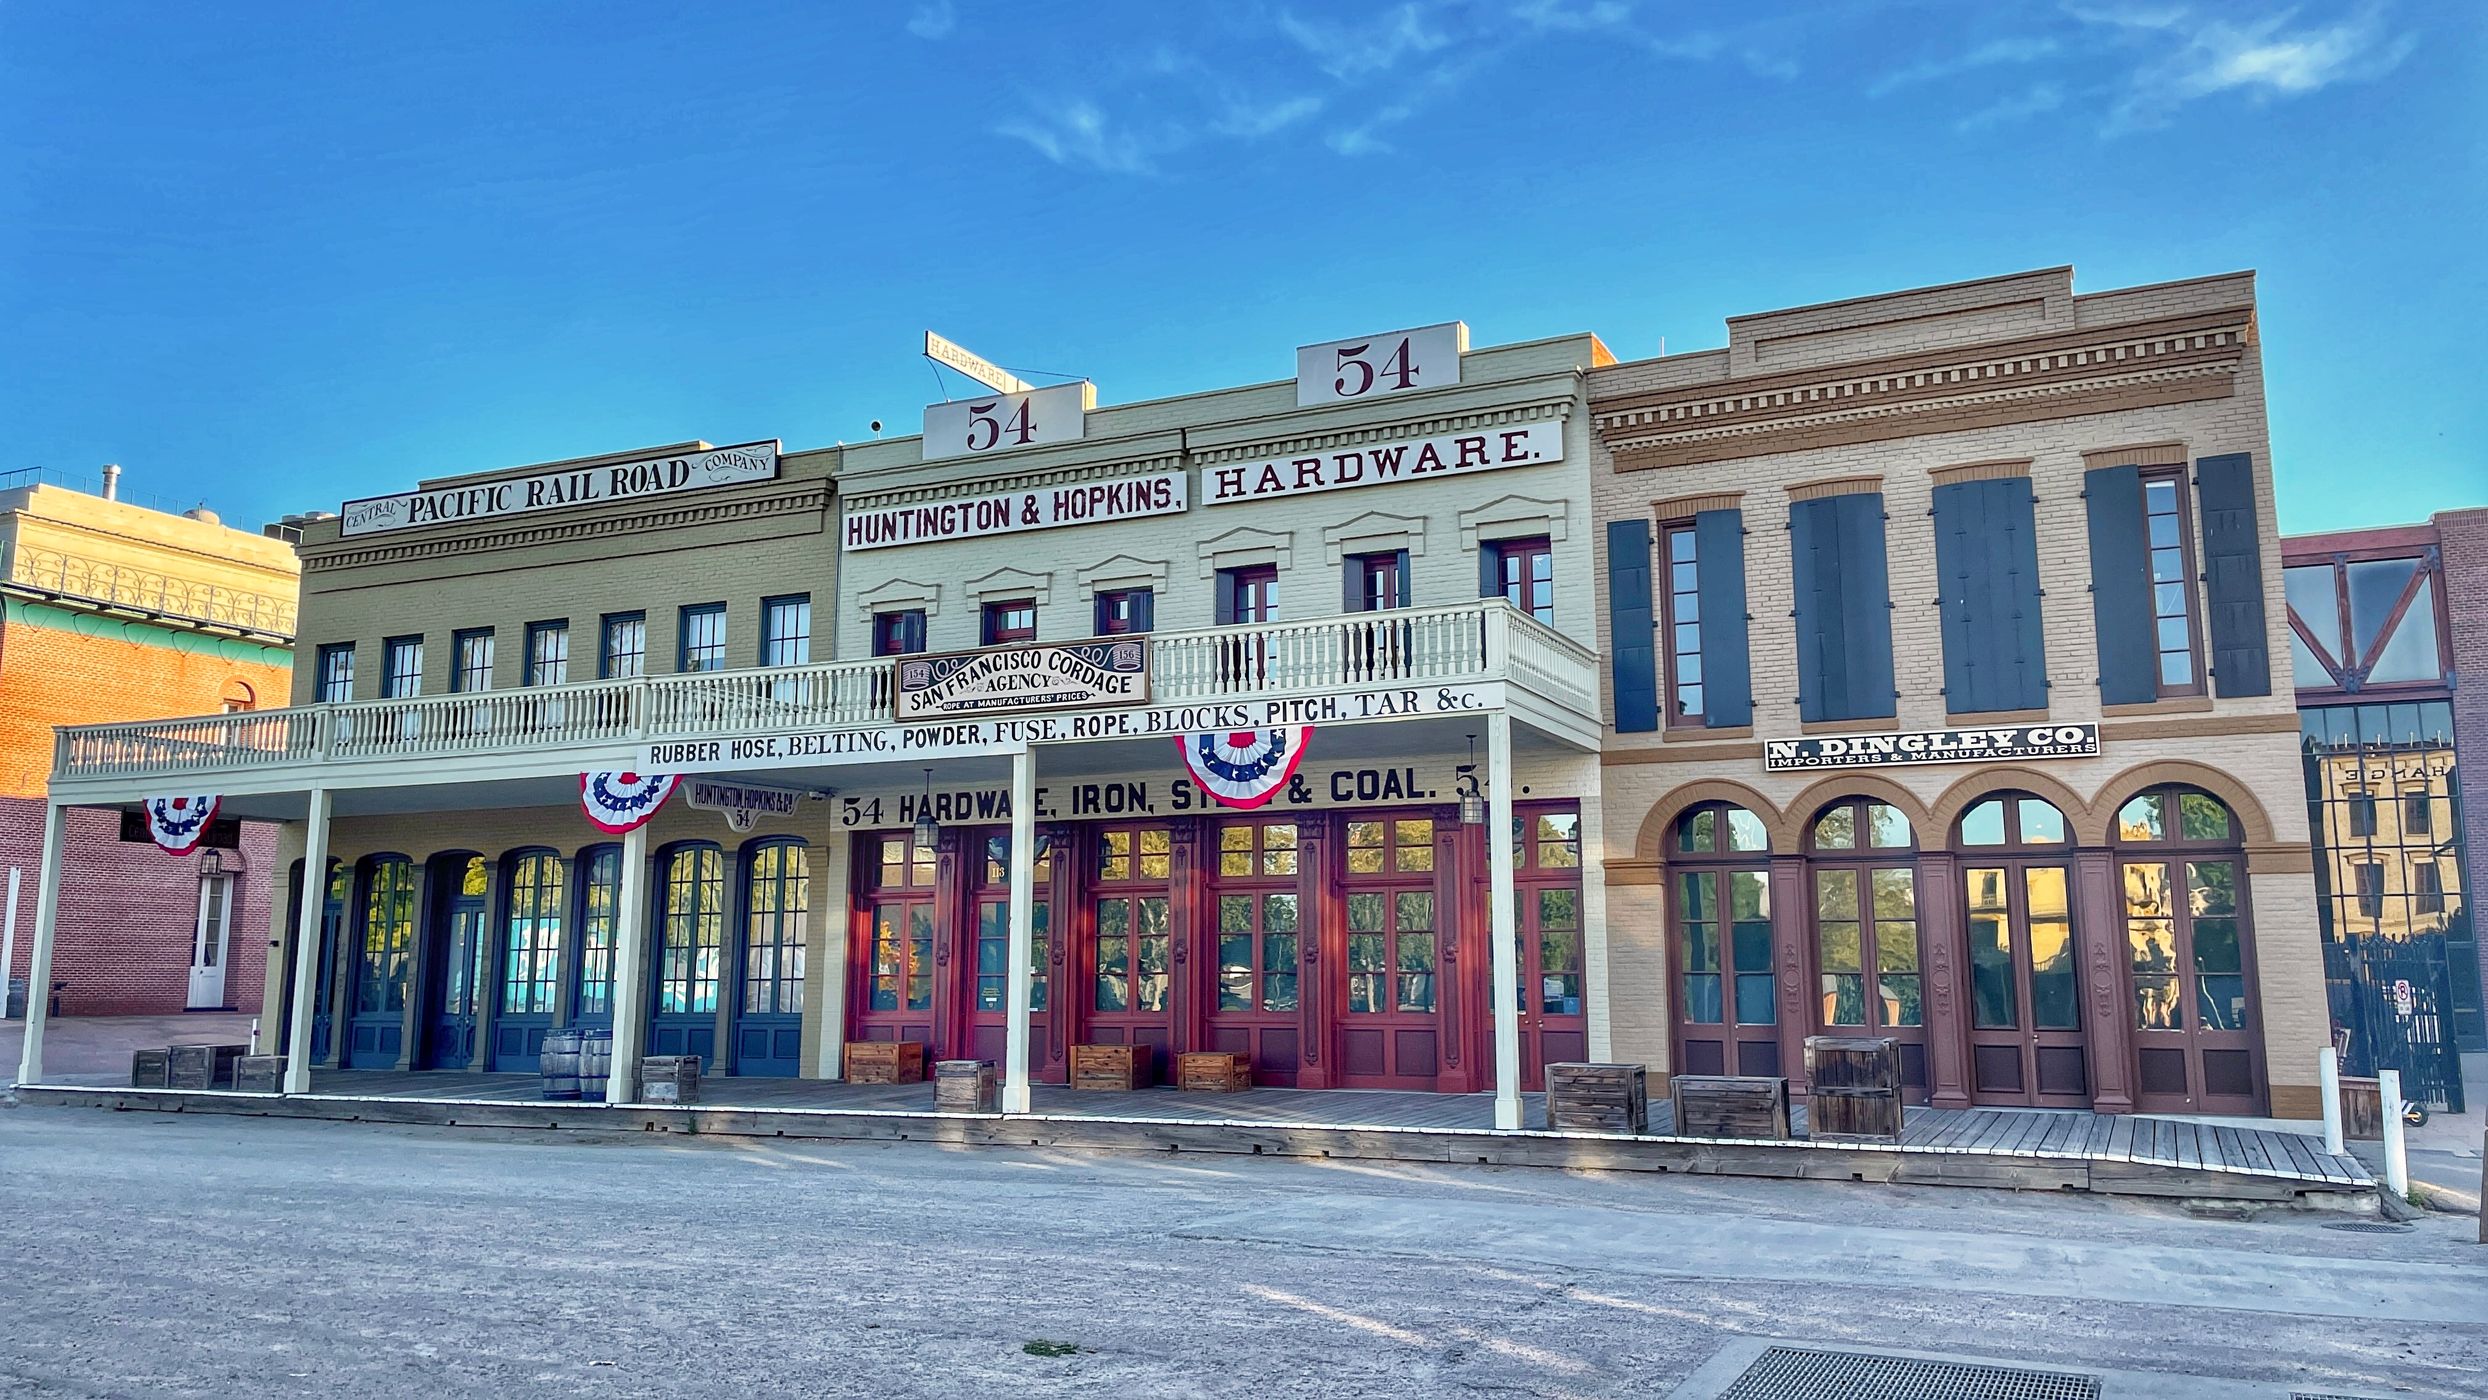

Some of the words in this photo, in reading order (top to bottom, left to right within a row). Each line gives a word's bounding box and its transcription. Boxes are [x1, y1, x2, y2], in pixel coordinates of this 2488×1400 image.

[931, 337, 1003, 386] HARDWARE
[1335, 337, 1420, 397] 54
[967, 397, 1038, 451] 54
[346, 501, 396, 528] CENTRAL
[407, 485, 512, 523] PACIFIC
[525, 473, 600, 508] RAIL
[610, 459, 690, 497] ROAD
[705, 452, 770, 472] COMPANY
[1215, 430, 1540, 499] HARDWARE.
[848, 500, 1010, 546] HUNTINGTON
[1021, 494, 1041, 525] &
[1053, 478, 1182, 522] HOPKINS,
[909, 669, 924, 679] 154
[1120, 649, 1135, 660] 156
[911, 686, 944, 711] SAN
[945, 650, 1042, 697] FRANCISCO
[1048, 651, 1133, 694] CORDAGE
[943, 702, 960, 711] ROPE
[963, 700, 975, 709] AT
[1056, 691, 1088, 702] PRICES
[985, 673, 1051, 693] AGENCY
[651, 742, 720, 765] RUBBER
[731, 738, 784, 760] HOSE,
[787, 730, 896, 756] BELTING,
[903, 723, 988, 749] POWDER,
[994, 718, 1066, 744] FUSE,
[1073, 713, 1138, 738] ROPE,
[1145, 705, 1260, 733] BLOCKS,
[1267, 697, 1347, 724] PITCH,
[1355, 690, 1420, 717] TAR
[1769, 741, 1809, 759] N.
[1819, 729, 2018, 757] DINGLEY
[2027, 726, 2095, 746] CO.
[1770, 753, 1882, 767] IMPORTERS
[1890, 752, 1903, 761] &
[1911, 743, 2096, 761] MANUFACTURERS
[736, 809, 750, 826] 54
[843, 797, 884, 826] 54
[900, 787, 1057, 823] HARDWAE,
[1072, 783, 1155, 815] IRON,
[1288, 773, 1312, 804] &
[1331, 767, 1437, 802] COAL.
